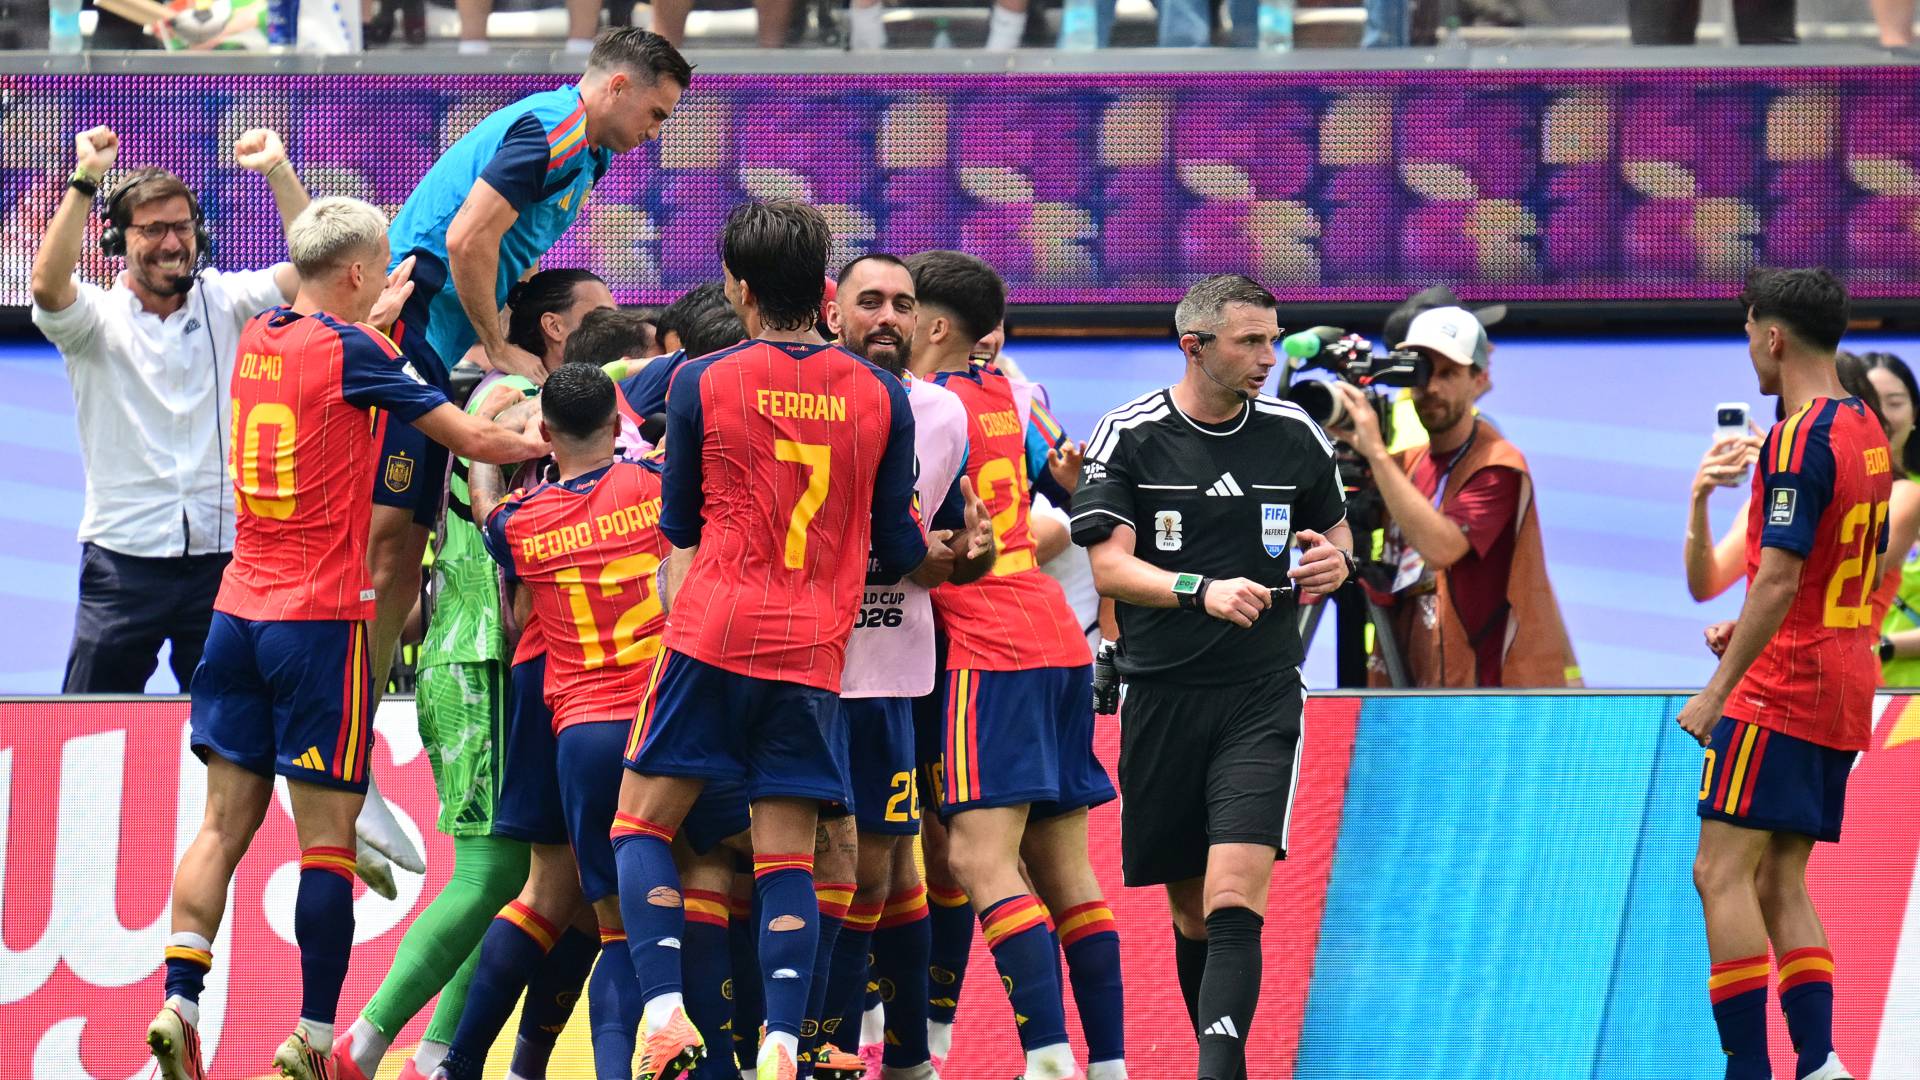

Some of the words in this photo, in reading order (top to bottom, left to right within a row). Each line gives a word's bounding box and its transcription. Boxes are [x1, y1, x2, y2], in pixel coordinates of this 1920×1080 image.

[240, 353, 282, 381] OLMO
[757, 390, 846, 422] FERRAN
[775, 438, 832, 570] 7
[1265, 508, 1288, 520] FIFA
[522, 522, 594, 564] PEDRO
[555, 553, 664, 671] 12
[880, 592, 905, 604] CUP
[854, 608, 903, 628] 026
